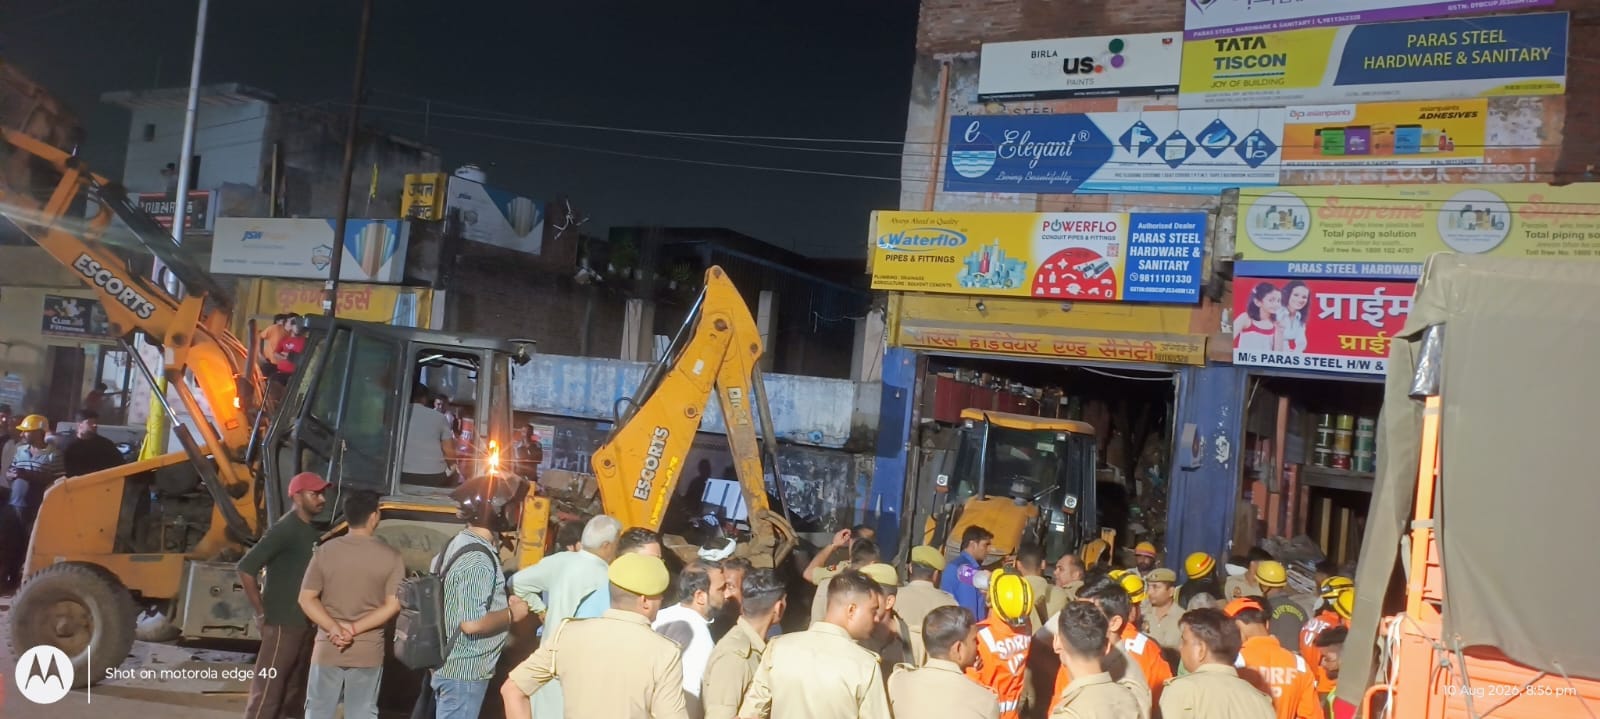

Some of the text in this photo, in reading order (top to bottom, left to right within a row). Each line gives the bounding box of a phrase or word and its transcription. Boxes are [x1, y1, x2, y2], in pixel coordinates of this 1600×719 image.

[1215, 36, 1266, 52] TATA
[1407, 29, 1507, 48] PARAS STEEL
[1031, 50, 1058, 58] BIRLA
[1364, 46, 1552, 70] HARDWARE & SANITARY
[1213, 53, 1287, 70] TISCON
[1066, 78, 1095, 86] PAINTS
[1211, 79, 1227, 88] JOY
[1243, 78, 1285, 87] BUILDING
[1417, 111, 1479, 120] ADHESIVES
[998, 129, 1076, 169] Elegant
[1318, 196, 1425, 225] Supreme
[1042, 219, 1117, 233] POWERFLO
[888, 230, 958, 247] Waterflo
[1132, 233, 1200, 244] PARAS STEEL
[1322, 230, 1416, 239] Total piping solution
[1525, 230, 1549, 239] Total
[1552, 232, 1584, 240] piping
[1130, 246, 1200, 257] HARDWARE &
[885, 254, 908, 262] PIPES
[918, 255, 955, 263] FITTINGS
[1138, 260, 1190, 271] SANITARY
[1288, 262, 1322, 273] PARAS
[1325, 263, 1357, 274] STEEL
[72, 253, 156, 320] ESCORTS
[1239, 352, 1384, 370] M/s PARAS STEEL H/W &
[633, 426, 669, 501] ESCORTS
